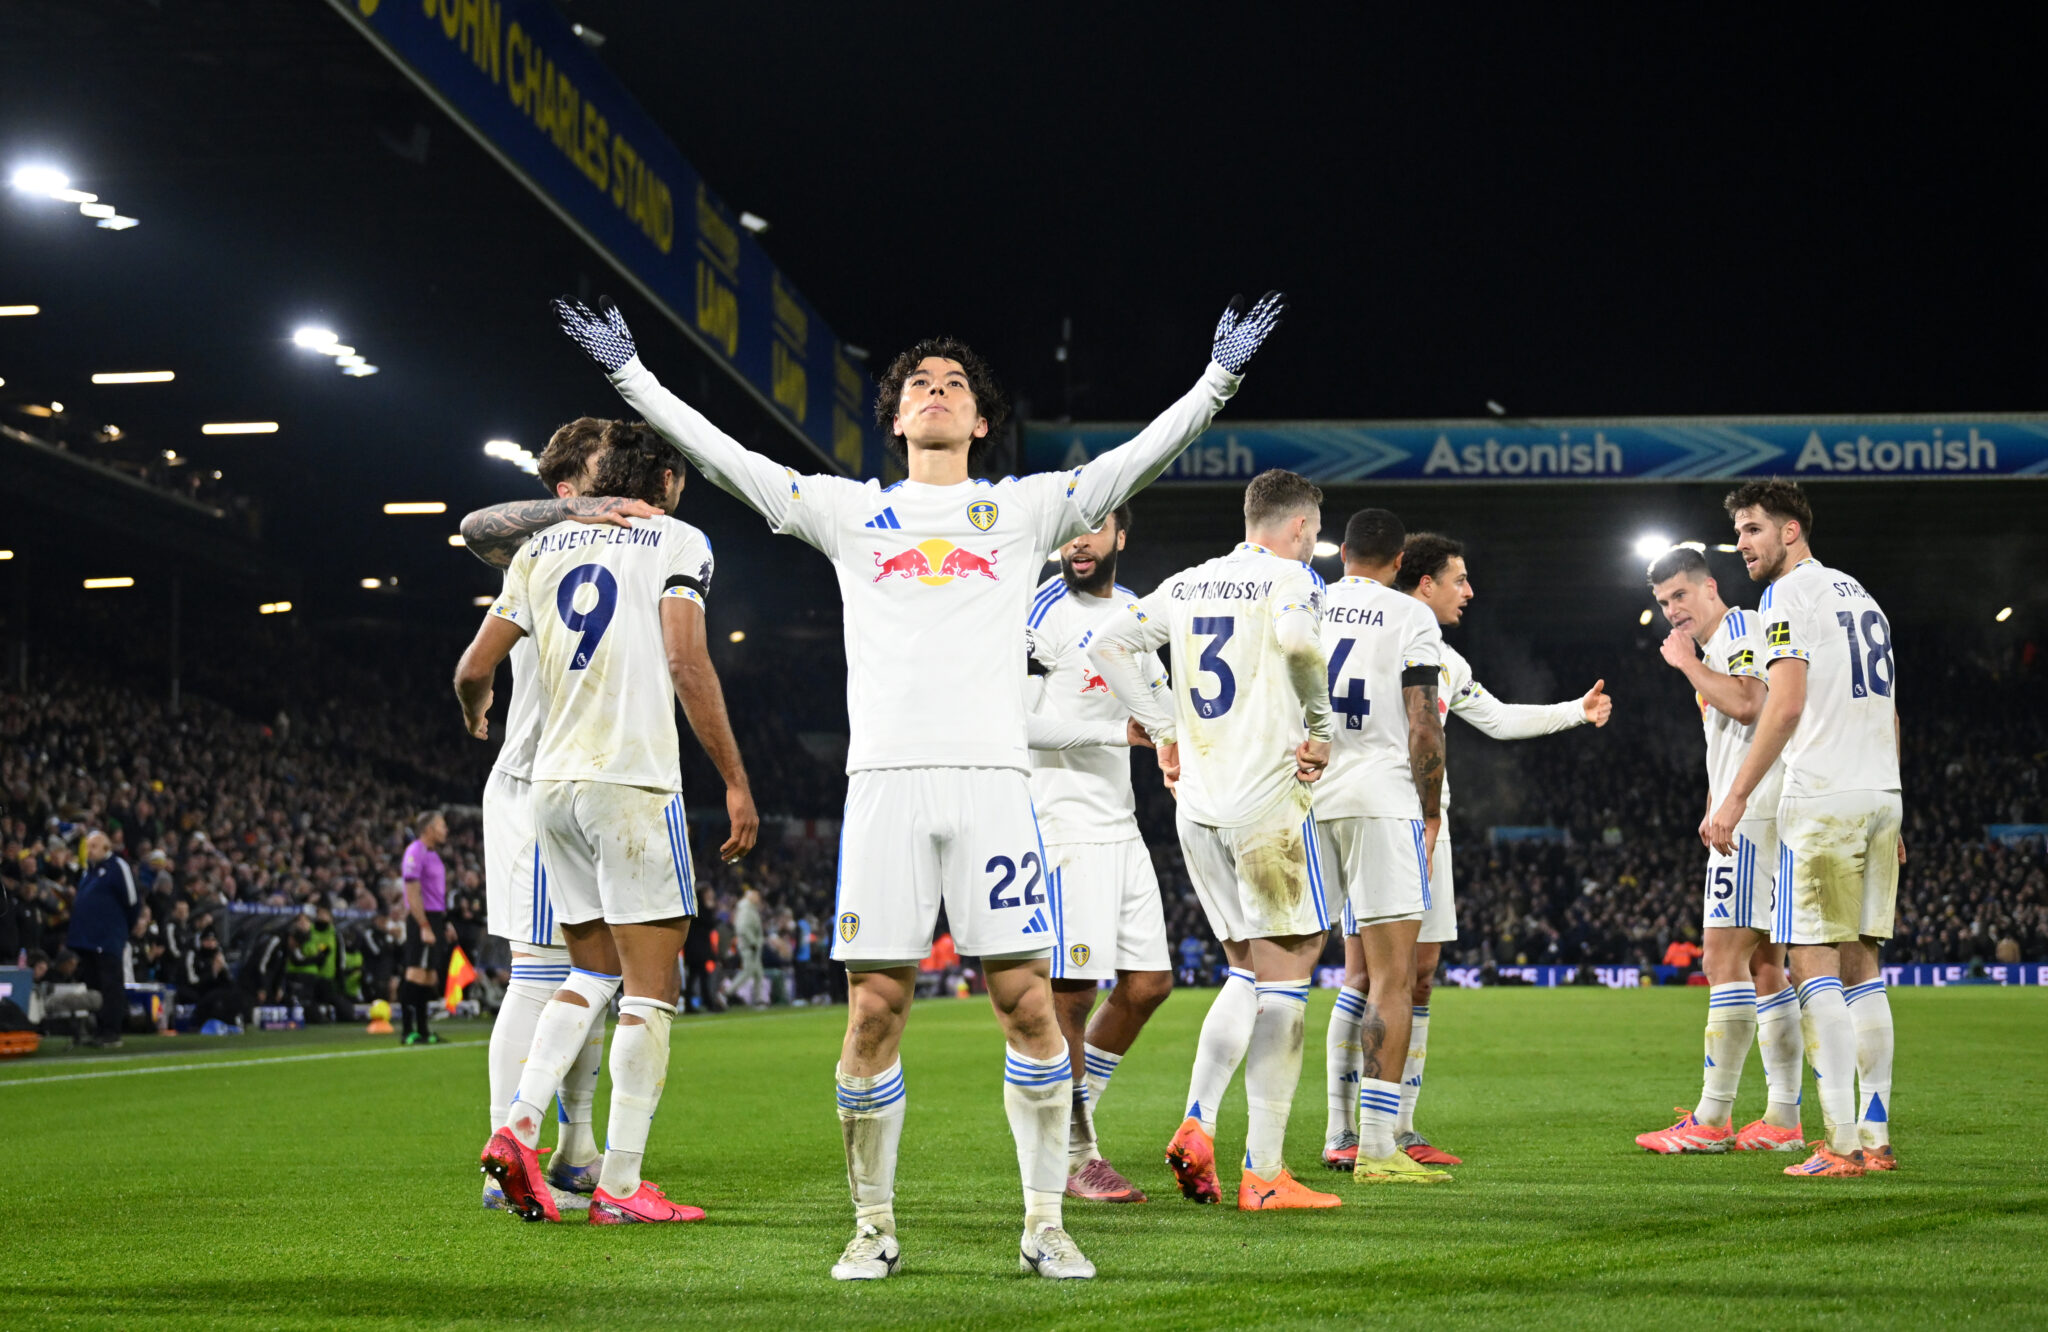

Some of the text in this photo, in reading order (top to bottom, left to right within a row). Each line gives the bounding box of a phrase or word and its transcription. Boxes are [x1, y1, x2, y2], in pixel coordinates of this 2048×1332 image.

[506, 21, 609, 192] CHARLES
[612, 133, 674, 254] STAND
[1062, 433, 1254, 475] Anish
[1423, 431, 1623, 474] Astonish
[1794, 428, 1997, 472] Astonish
[530, 527, 662, 557] CALVERT-LEWIN
[557, 563, 618, 670] 9
[1190, 616, 1236, 719] 3
[1836, 610, 1894, 699] 18
[1304, 638, 1370, 731] 4
[985, 851, 1045, 910] 22
[1707, 867, 1733, 899] 15
